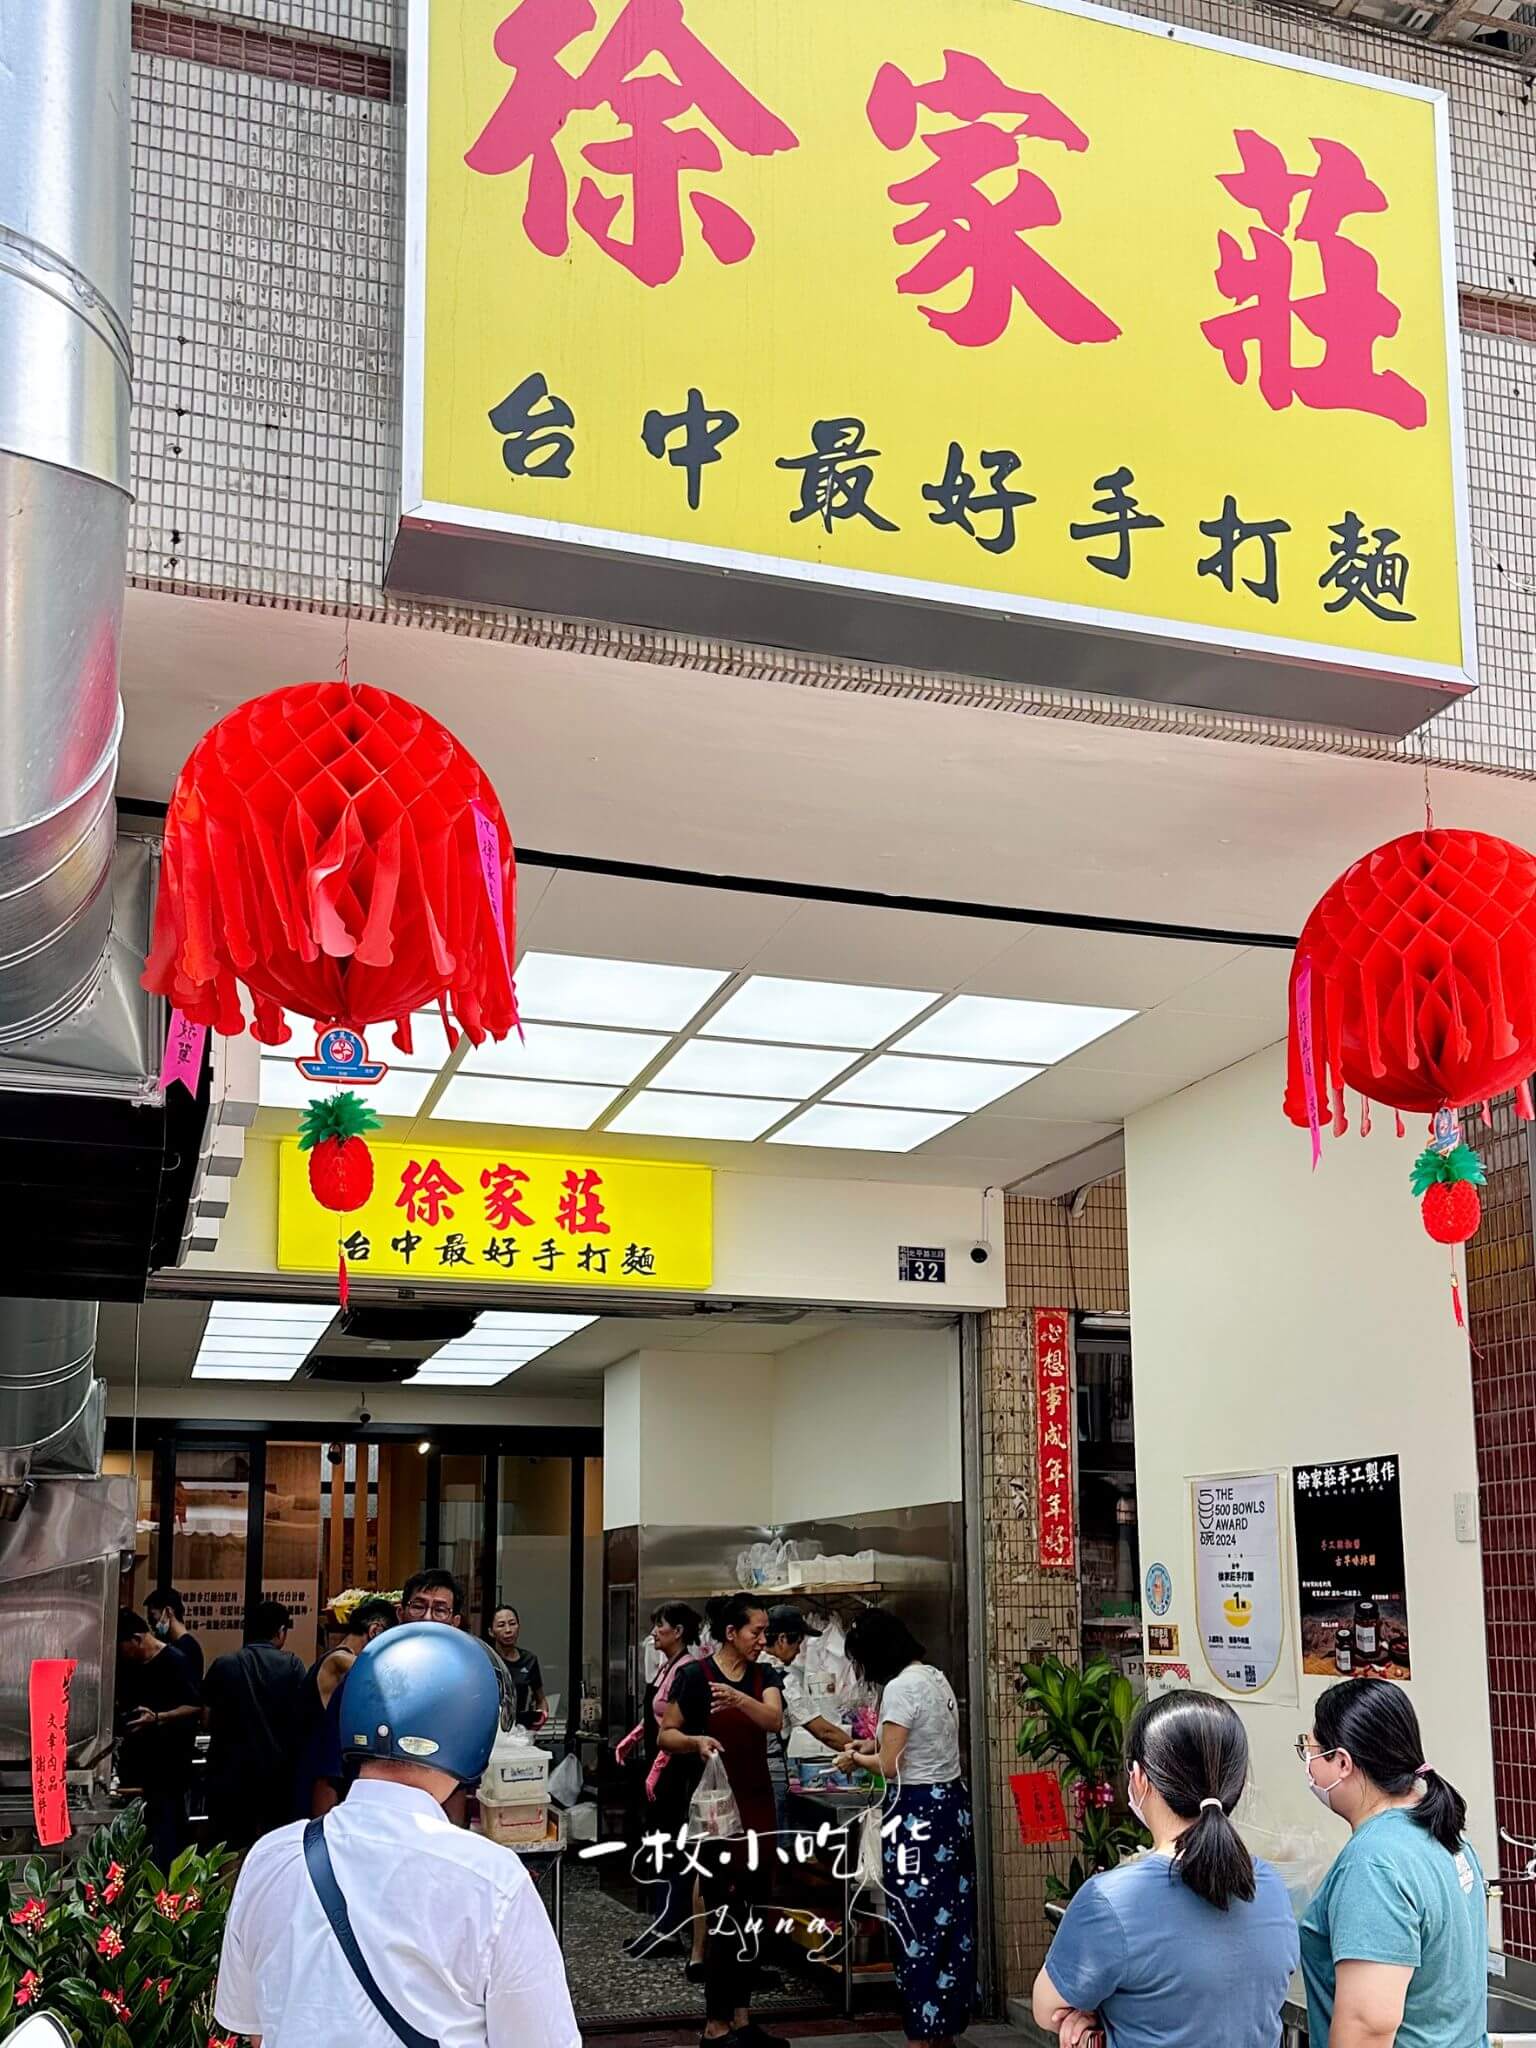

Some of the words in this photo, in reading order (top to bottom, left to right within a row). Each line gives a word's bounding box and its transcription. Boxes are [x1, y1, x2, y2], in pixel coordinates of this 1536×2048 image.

[464, 0, 1427, 429] 徐家莊
[488, 372, 1416, 622] 台中最好手打麵
[395, 1159, 611, 1235] 徐家莊
[343, 1230, 656, 1275] 台中最好手打麵
[915, 1262, 938, 1280] 32
[1040, 1323, 1068, 1553] 心想事成年年好
[1297, 1461, 1396, 1490] 徐家莊手工製作
[1215, 1488, 1234, 1501] THE
[1215, 1504, 1231, 1516] 500
[1232, 1501, 1265, 1516] BOWLS
[1215, 1518, 1249, 1531] AWARD
[1216, 1534, 1237, 1546] 2024
